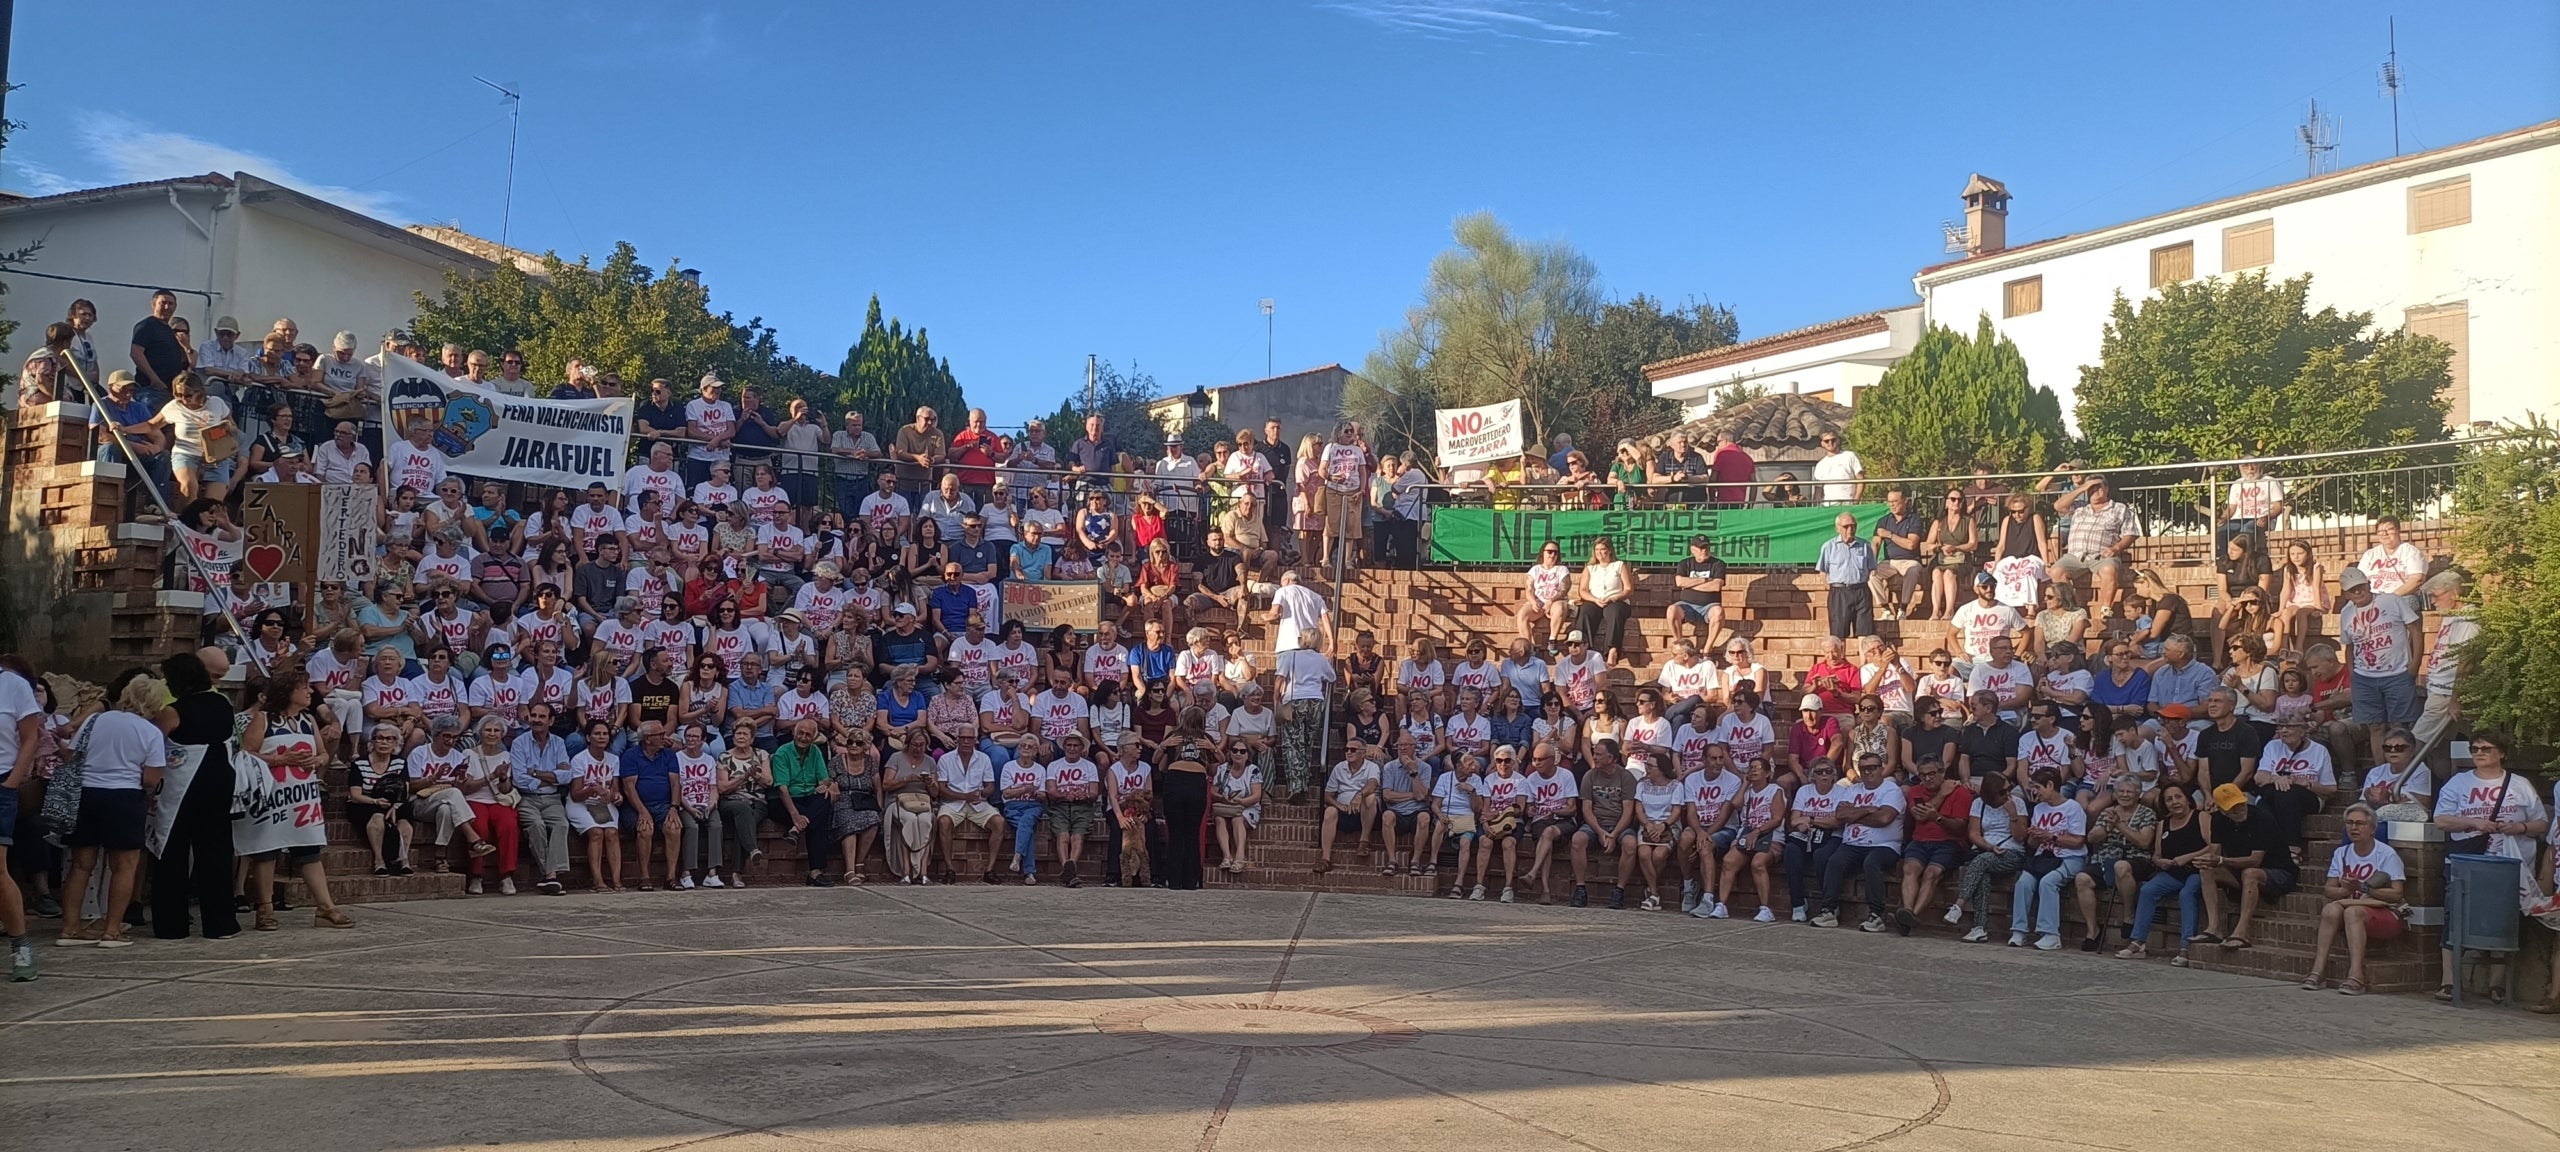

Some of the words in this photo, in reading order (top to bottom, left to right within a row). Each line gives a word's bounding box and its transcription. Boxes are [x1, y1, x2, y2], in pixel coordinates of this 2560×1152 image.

[331, 367, 351, 379] NYC
[537, 406, 625, 435] VALENCIANISTA
[704, 409, 721, 422] NO
[1452, 412, 1482, 438] NO
[1484, 416, 1493, 426] AL
[1448, 423, 1511, 451] MACROVERTEDERO
[1335, 448, 1353, 456] NO
[1469, 437, 1508, 457] ZARRA
[407, 454, 430, 467] NO
[500, 437, 615, 477] JARAFUEL
[647, 475, 667, 485] NO
[757, 495, 776, 505] NO
[874, 504, 892, 516] NO
[248, 489, 301, 566] ZARRA
[588, 516, 607, 528] NO
[1602, 511, 1718, 531] SOMOS
[336, 486, 351, 579] VERTEDERO
[1493, 513, 1553, 559] NO
[679, 534, 698, 545] NO
[773, 536, 791, 549] NO
[1556, 533, 1655, 558] COMRCA
[187, 536, 218, 561] NO
[348, 528, 370, 576] NO
[2008, 559, 2030, 571] NO
[2370, 558, 2398, 571] NO
[1539, 573, 1556, 582] NO
[1008, 583, 1042, 606] NO
[1051, 587, 1065, 596] AL
[812, 596, 834, 607] NO
[1004, 593, 1099, 620] MACROVERTEDERO
[1043, 617, 1057, 626] DE
[1974, 614, 1997, 628] NO
[2353, 607, 2379, 632] NO
[443, 623, 465, 636] NO
[612, 632, 634, 646] NO
[661, 630, 683, 644] NO
[717, 636, 738, 651] NO
[964, 649, 982, 661] NO
[1004, 653, 1024, 666] NO
[1096, 656, 1116, 668] NO
[326, 670, 350, 685] NO
[1412, 676, 1431, 687] NO
[1462, 674, 1483, 686] NO
[1678, 673, 1699, 686] NO
[380, 688, 403, 705] NO
[430, 689, 452, 700] NO
[592, 691, 611, 707] NO
[795, 703, 816, 717] NO
[1051, 705, 1071, 716] NO
[1457, 726, 1477, 738] NO
[1632, 729, 1653, 741] NO
[1730, 727, 1754, 740] NO
[1685, 738, 1708, 751] NO
[685, 763, 708, 778] NO
[2275, 758, 2309, 771] NO
[586, 764, 610, 779] NO
[1014, 772, 1035, 784] NO
[1058, 769, 1082, 782] NO
[1123, 774, 1143, 788] NO
[1491, 784, 1514, 796] NO
[1537, 784, 1558, 799] NO
[1699, 786, 1721, 800] NO
[1805, 797, 1829, 808] NO
[1854, 792, 1875, 804] NO
[273, 810, 288, 824] DE
[2038, 812, 2063, 827] NO
